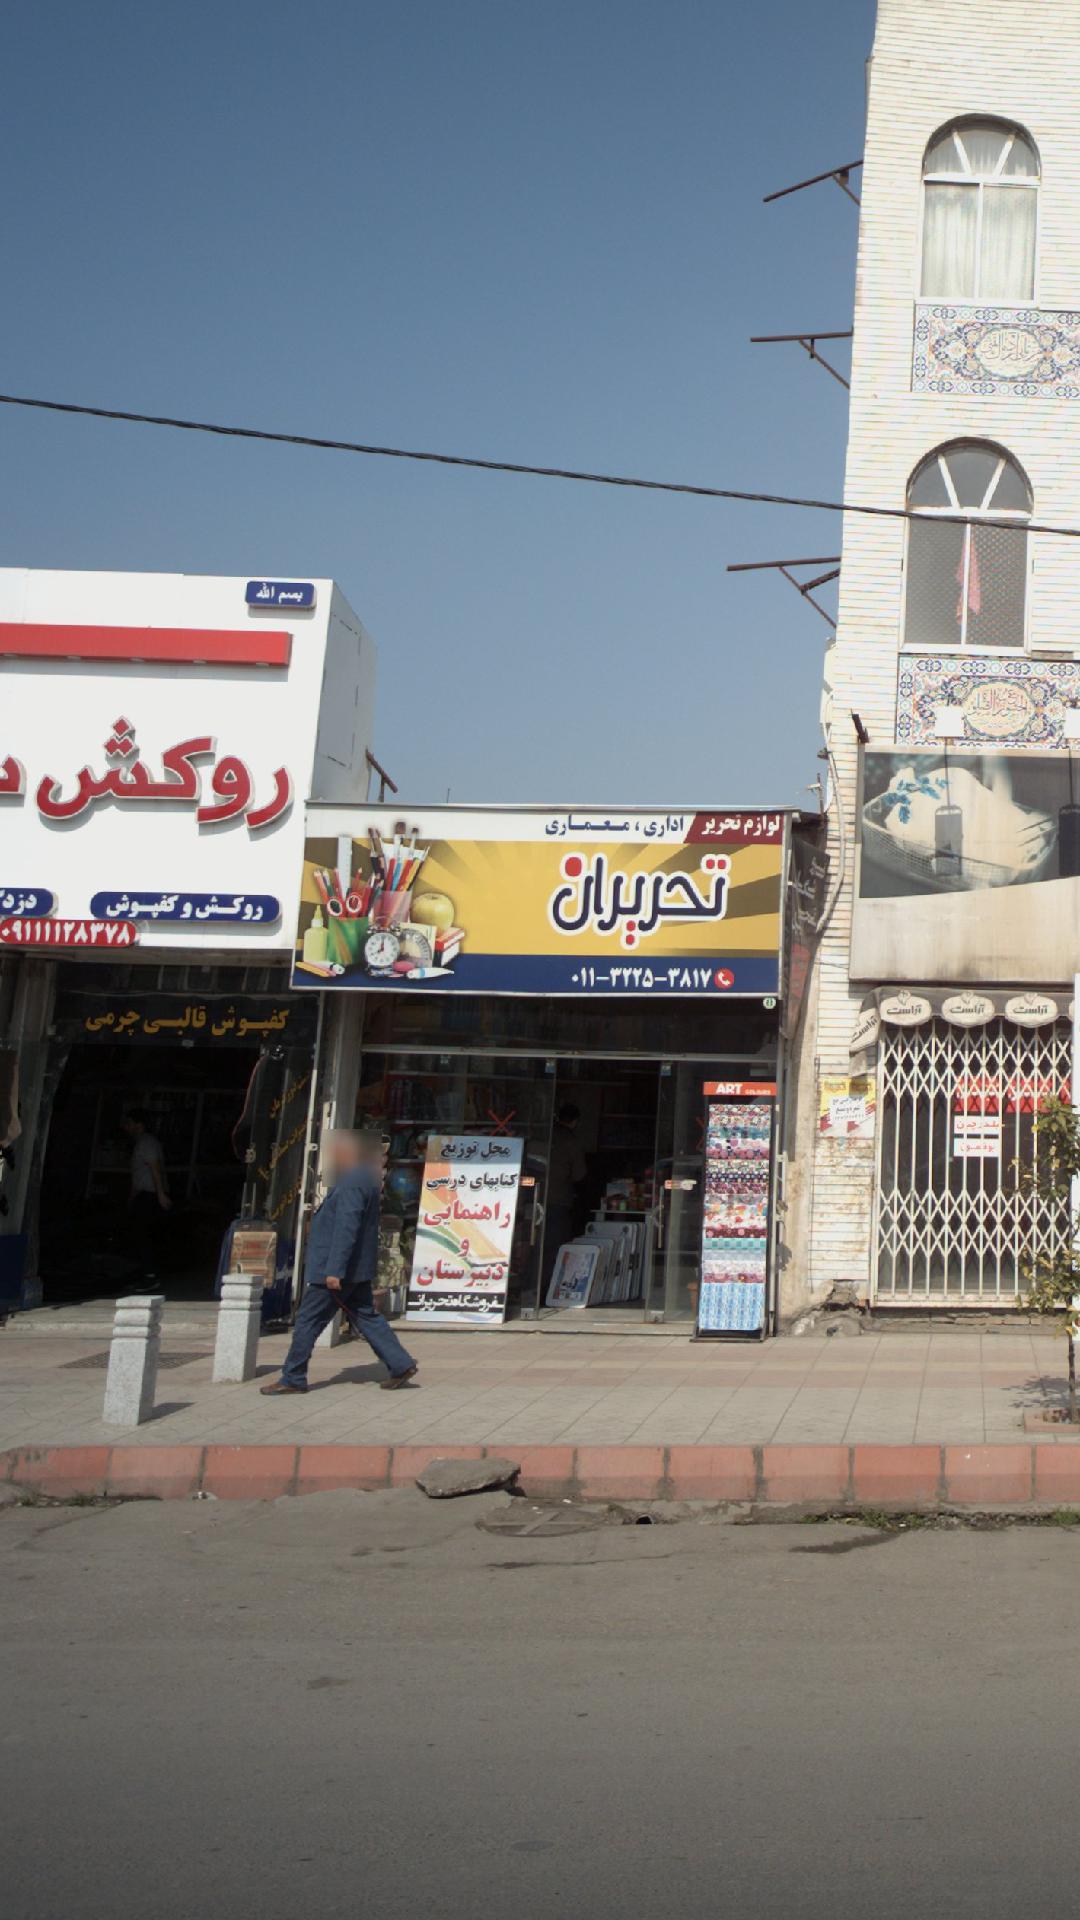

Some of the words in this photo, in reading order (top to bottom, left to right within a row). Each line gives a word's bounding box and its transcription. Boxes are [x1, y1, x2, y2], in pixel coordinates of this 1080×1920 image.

[256, 583, 275, 600] الله
[279, 588, 304, 604] بسم
[36, 715, 290, 829] روکش
[545, 814, 630, 836] معماری
[701, 813, 741, 836] تحریر
[744, 814, 780, 836] لوازم
[106, 895, 179, 919] کفپوش
[180, 901, 192, 918] و
[196, 896, 264, 920] روکش
[549, 853, 730, 948] تحریران
[1, 919, 131, 944] ۰۹۱۱۱۱۲۸۳۷۸
[86, 1008, 140, 1035] چرمی
[143, 1005, 207, 1036] قالبی
[211, 1005, 290, 1036] کفپوش
[715, 1082, 743, 1095] ART
[441, 1140, 479, 1159] توزیع
[481, 1141, 510, 1158] محل
[426, 1173, 465, 1190] درسی
[469, 1172, 518, 1190] کتابهای
[424, 1200, 511, 1228] راهنمایی
[458, 1236, 470, 1256] و
[416, 1259, 505, 1287] دبیرستان
